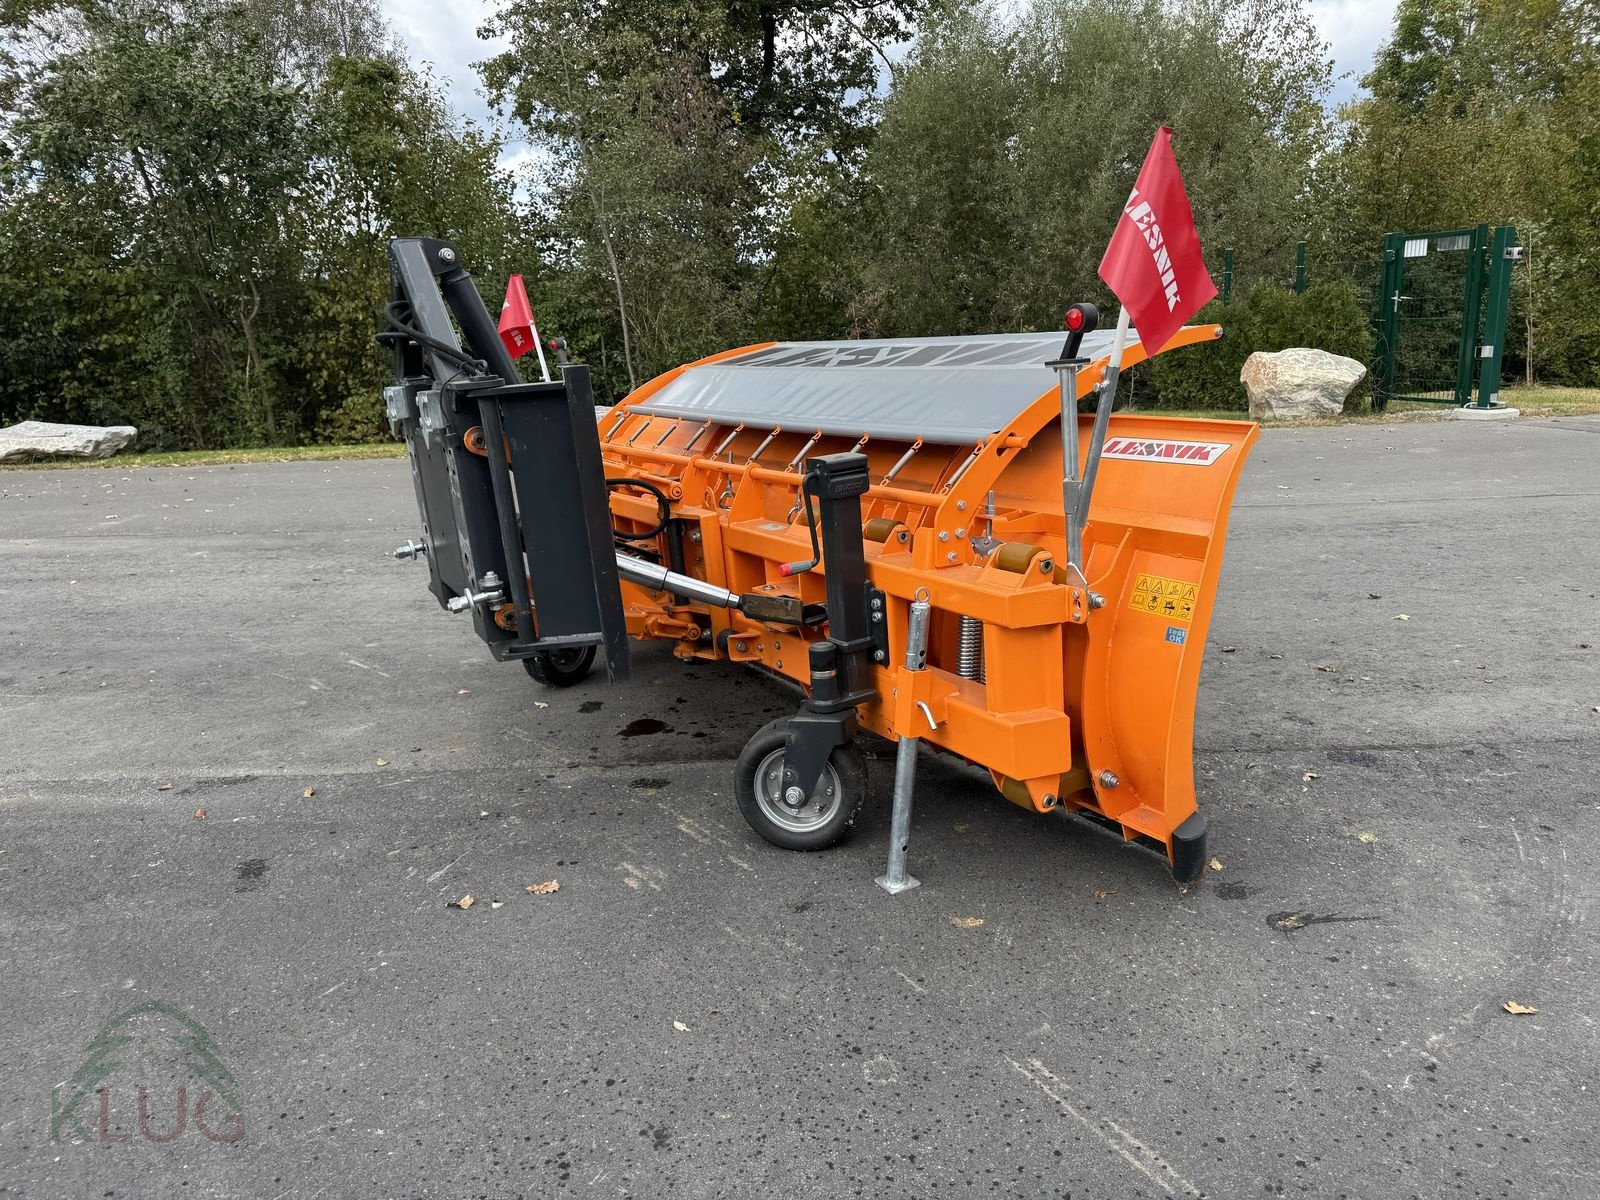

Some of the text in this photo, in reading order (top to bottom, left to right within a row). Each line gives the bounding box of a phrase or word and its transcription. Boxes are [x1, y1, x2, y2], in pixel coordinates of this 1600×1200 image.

[1124, 187, 1181, 313] LESNIK
[1103, 440, 1219, 461] LESNIK
[1169, 635, 1182, 644] OK
